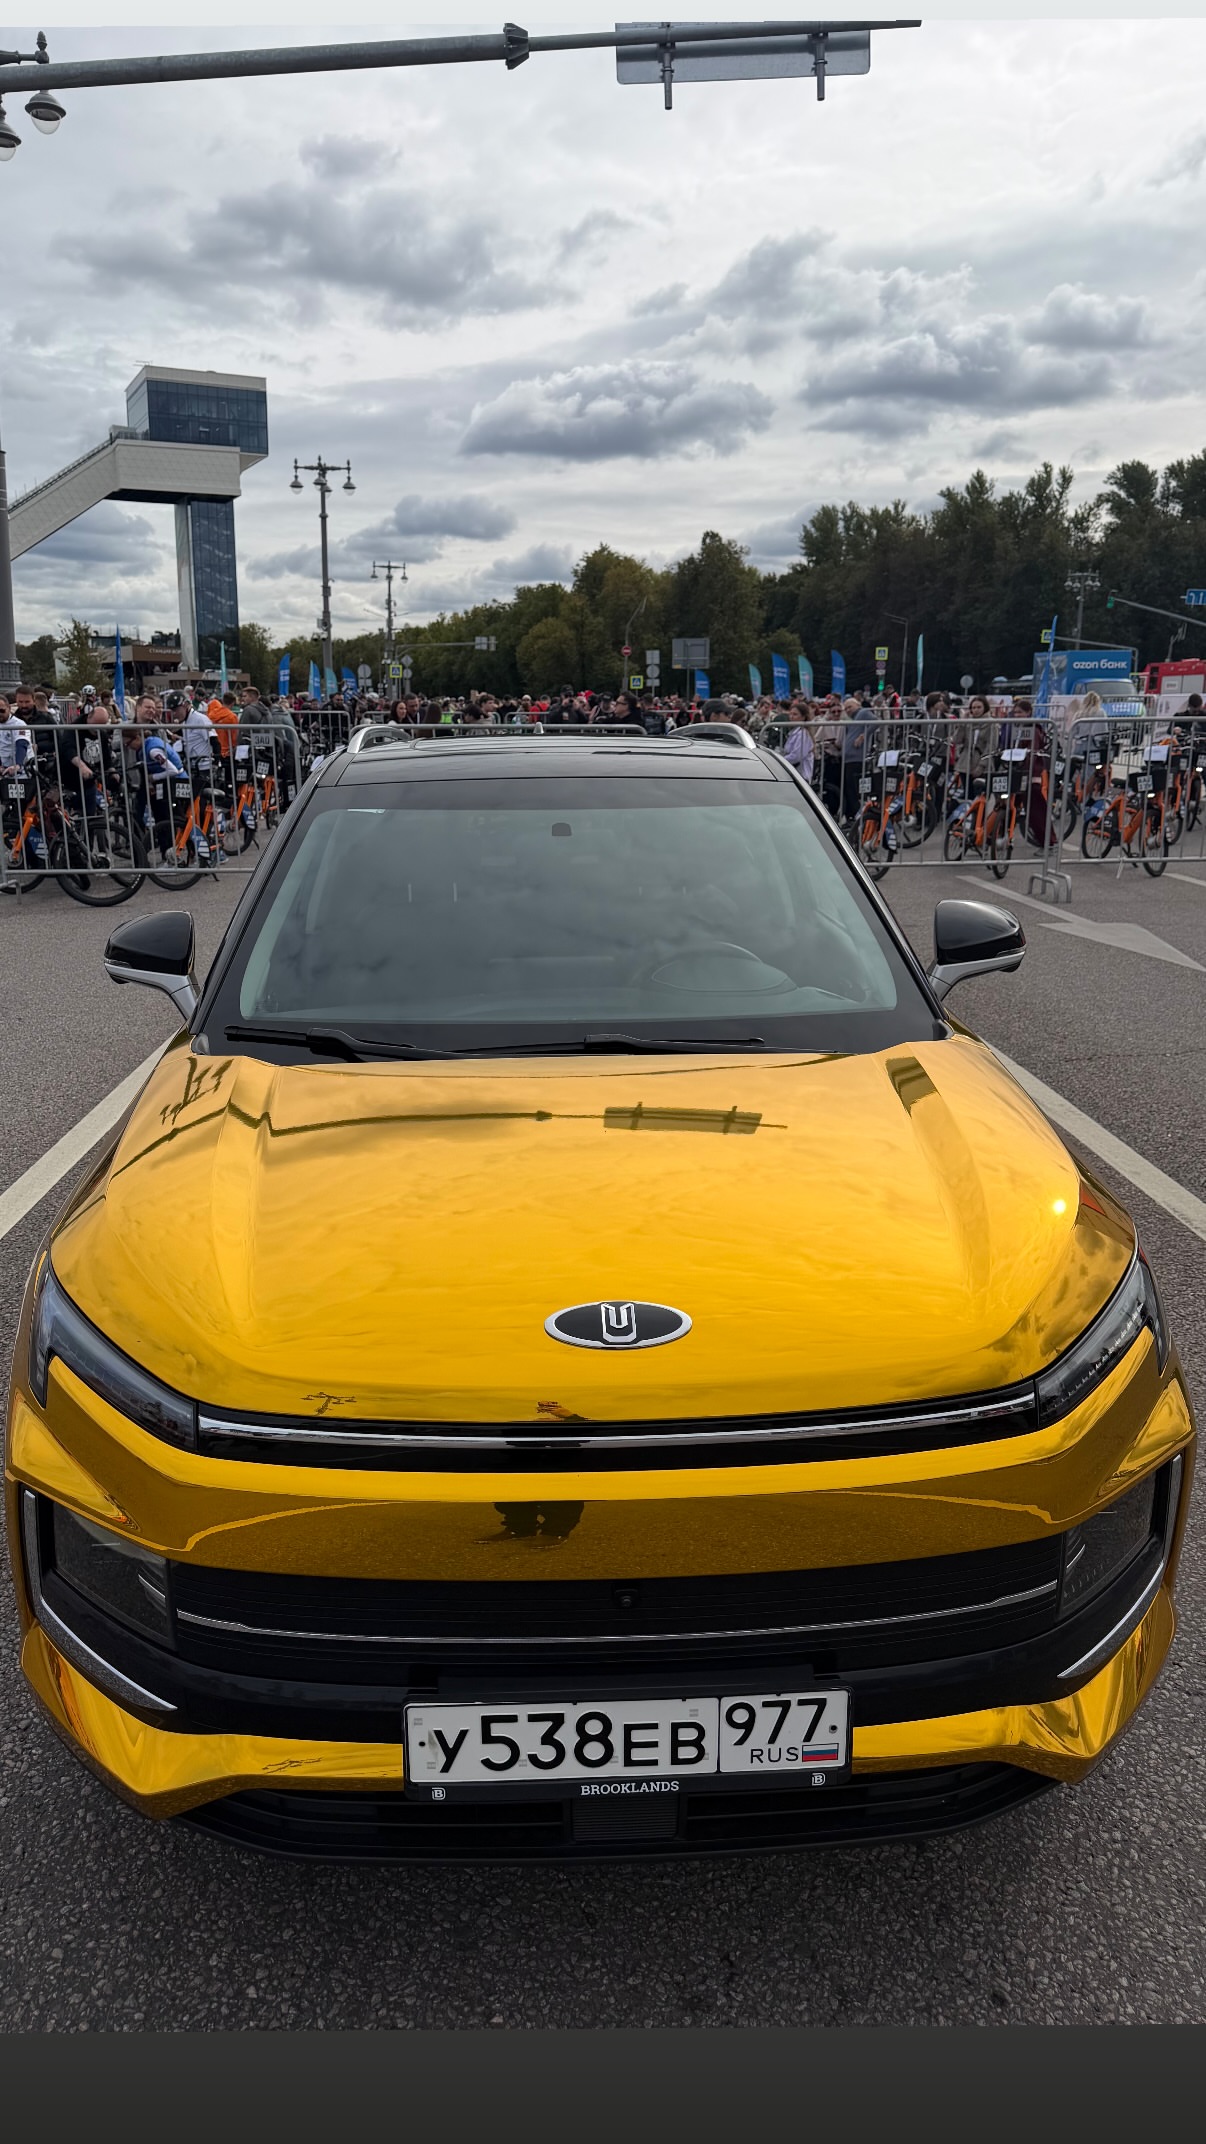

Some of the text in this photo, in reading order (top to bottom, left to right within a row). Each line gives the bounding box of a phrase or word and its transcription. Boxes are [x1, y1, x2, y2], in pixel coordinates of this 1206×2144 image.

[1073, 659, 1127, 669] ozon банк
[725, 1698, 828, 1747] 977
[750, 1746, 799, 1765] RUS
[580, 1780, 680, 1796] BROOKLANDS
